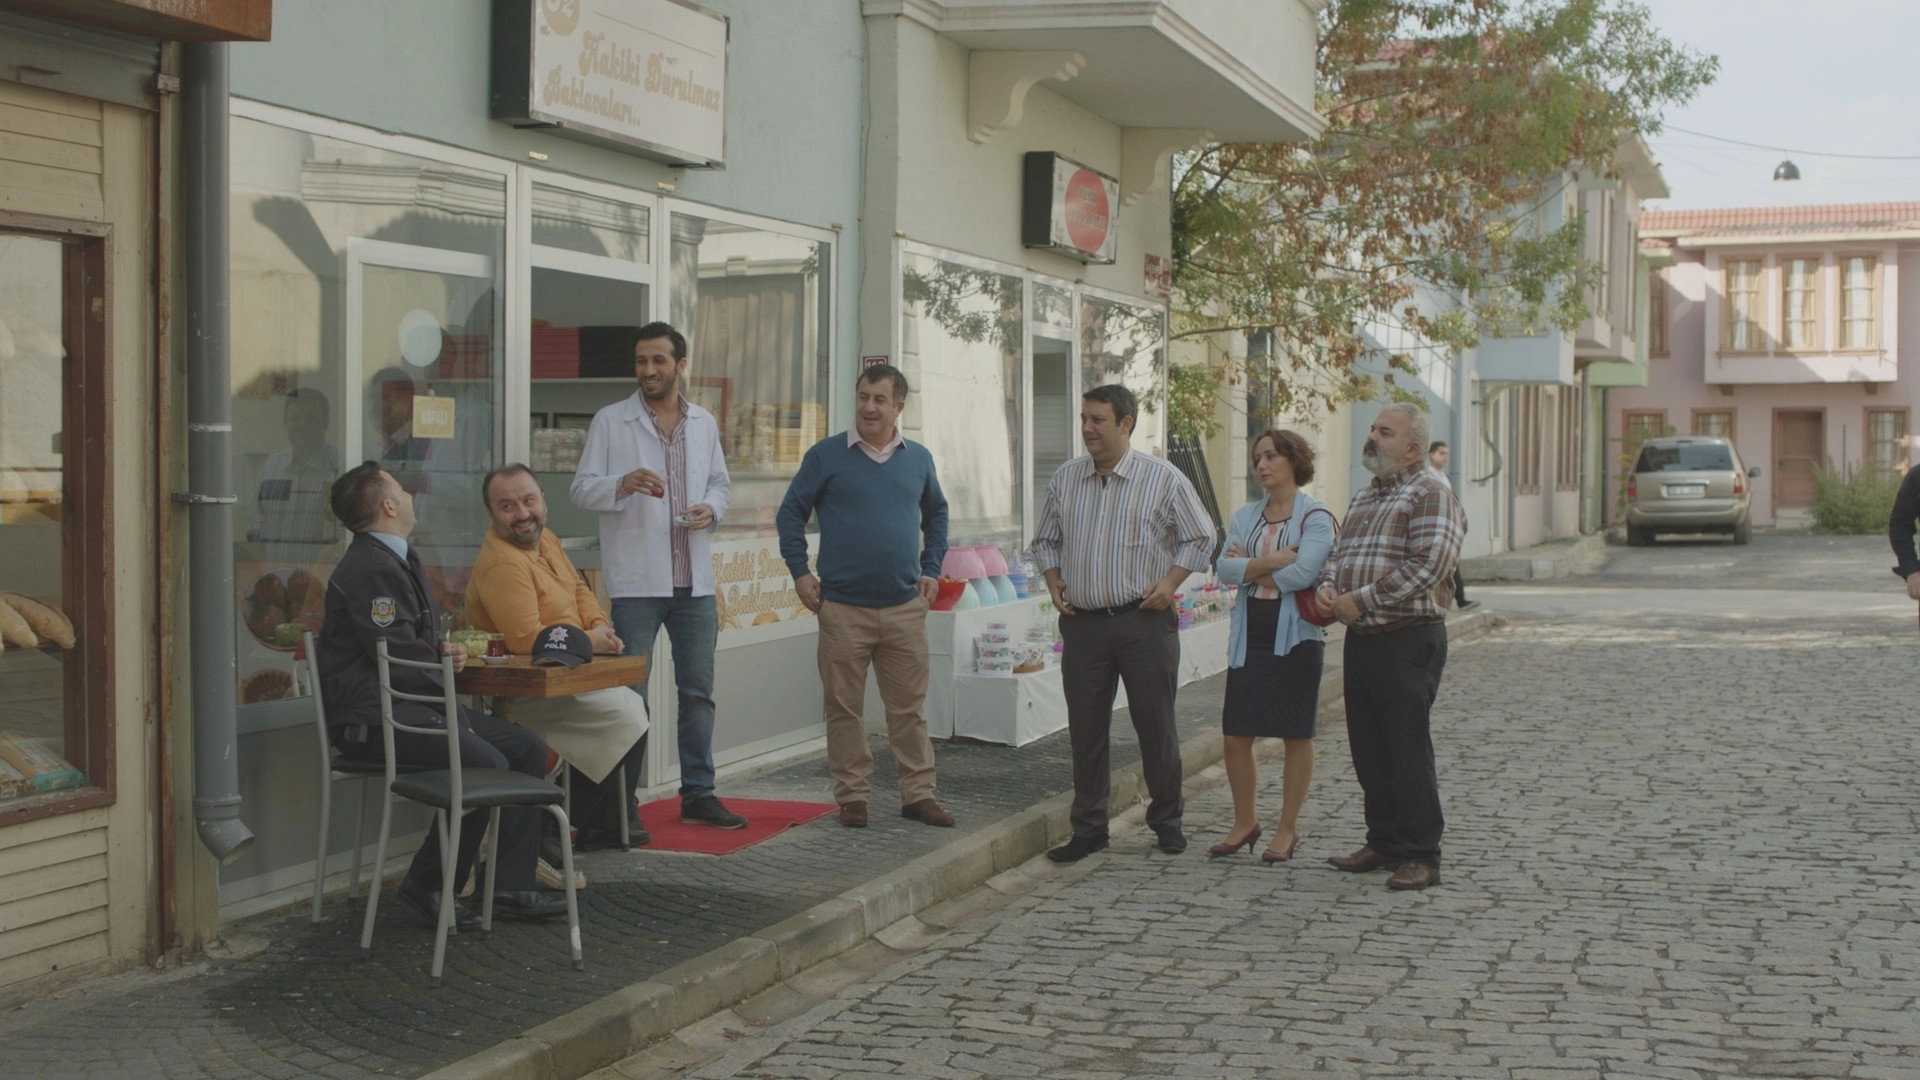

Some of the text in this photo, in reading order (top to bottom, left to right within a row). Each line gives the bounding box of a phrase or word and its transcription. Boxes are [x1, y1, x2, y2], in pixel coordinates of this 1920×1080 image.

[578, 30, 641, 88] Hakiki
[421, 408, 448, 425] KAPALI
[544, 642, 567, 650] POLİS
